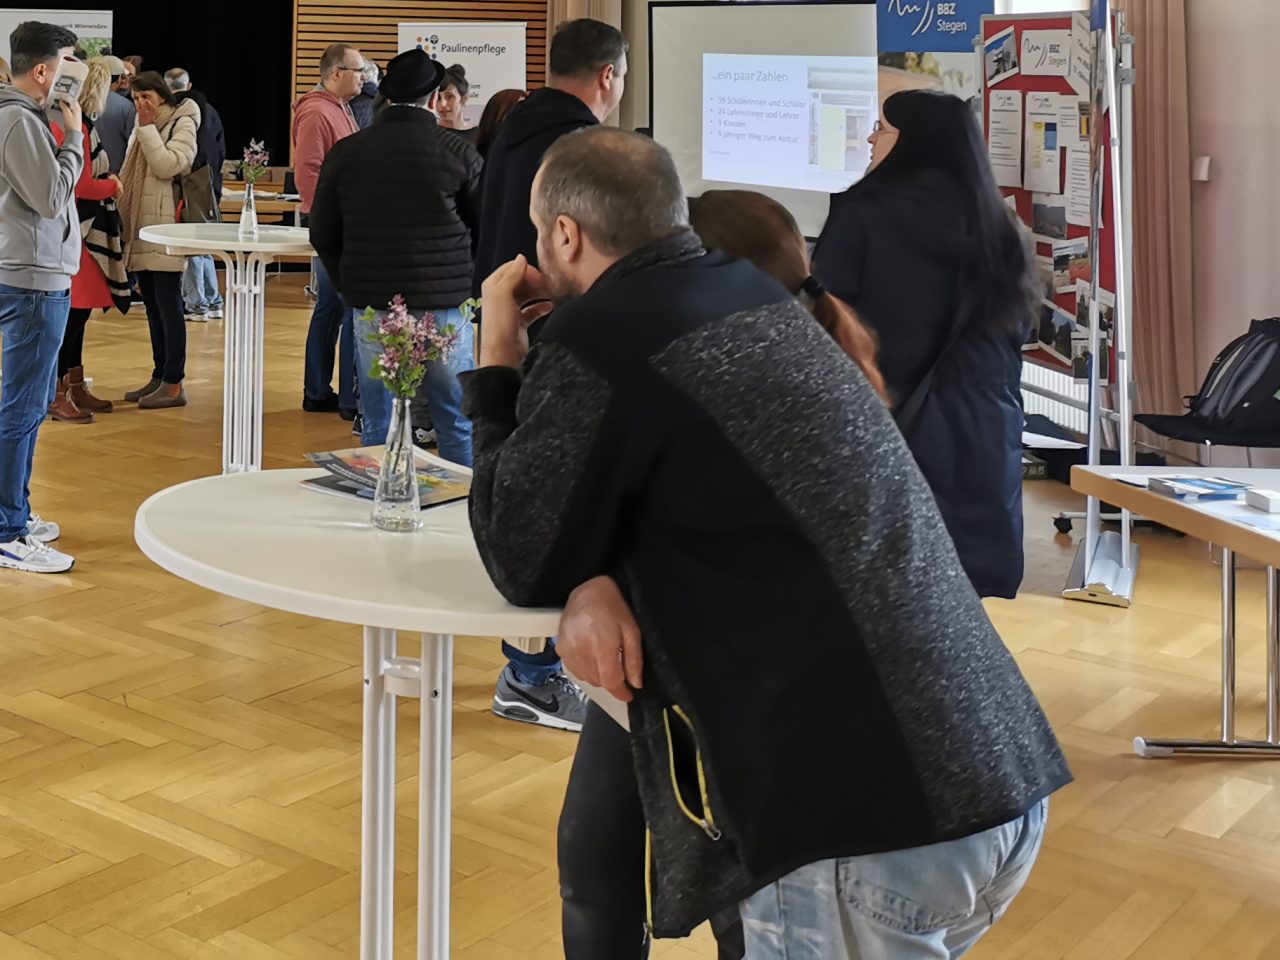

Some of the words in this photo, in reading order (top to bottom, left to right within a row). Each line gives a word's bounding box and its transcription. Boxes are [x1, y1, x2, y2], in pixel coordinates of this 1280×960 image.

[937, 3, 956, 15] BBZ
[937, 19, 967, 34] Stegen
[441, 43, 506, 56] Paulinenpflege
[733, 72, 755, 83] paar
[756, 71, 789, 82] Zahlen
[768, 99, 781, 107] und
[765, 111, 778, 119] und
[779, 112, 801, 120] Lehrer
